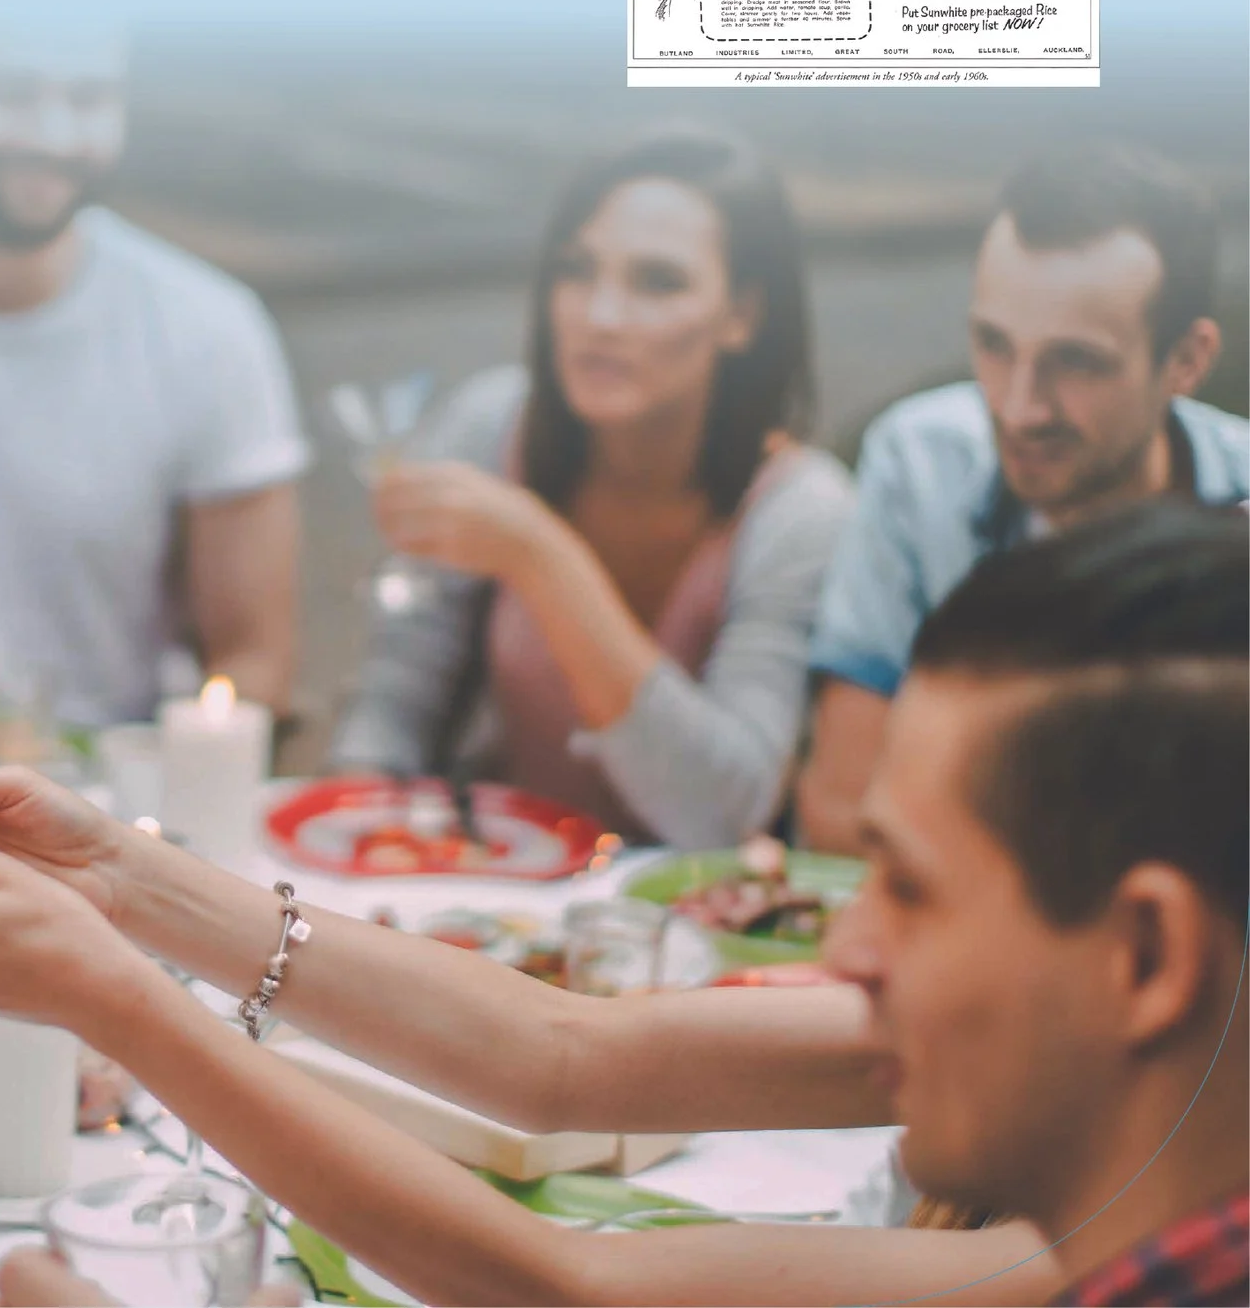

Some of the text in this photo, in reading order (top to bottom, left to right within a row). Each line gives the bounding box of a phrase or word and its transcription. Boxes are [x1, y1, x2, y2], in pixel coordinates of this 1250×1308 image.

[902, 22, 913, 32] on
[917, 22, 939, 34] your
[942, 21, 980, 34] grocery
[982, 20, 999, 31] list
[735, 71, 742, 81] A
[744, 71, 771, 83] typical
[816, 71, 870, 82] advertisement
[872, 72, 881, 81] in
[883, 71, 896, 82] the
[898, 72, 922, 82] 1950s
[924, 71, 940, 82] and
[942, 71, 961, 83] early
[964, 71, 989, 82] 1960s.
